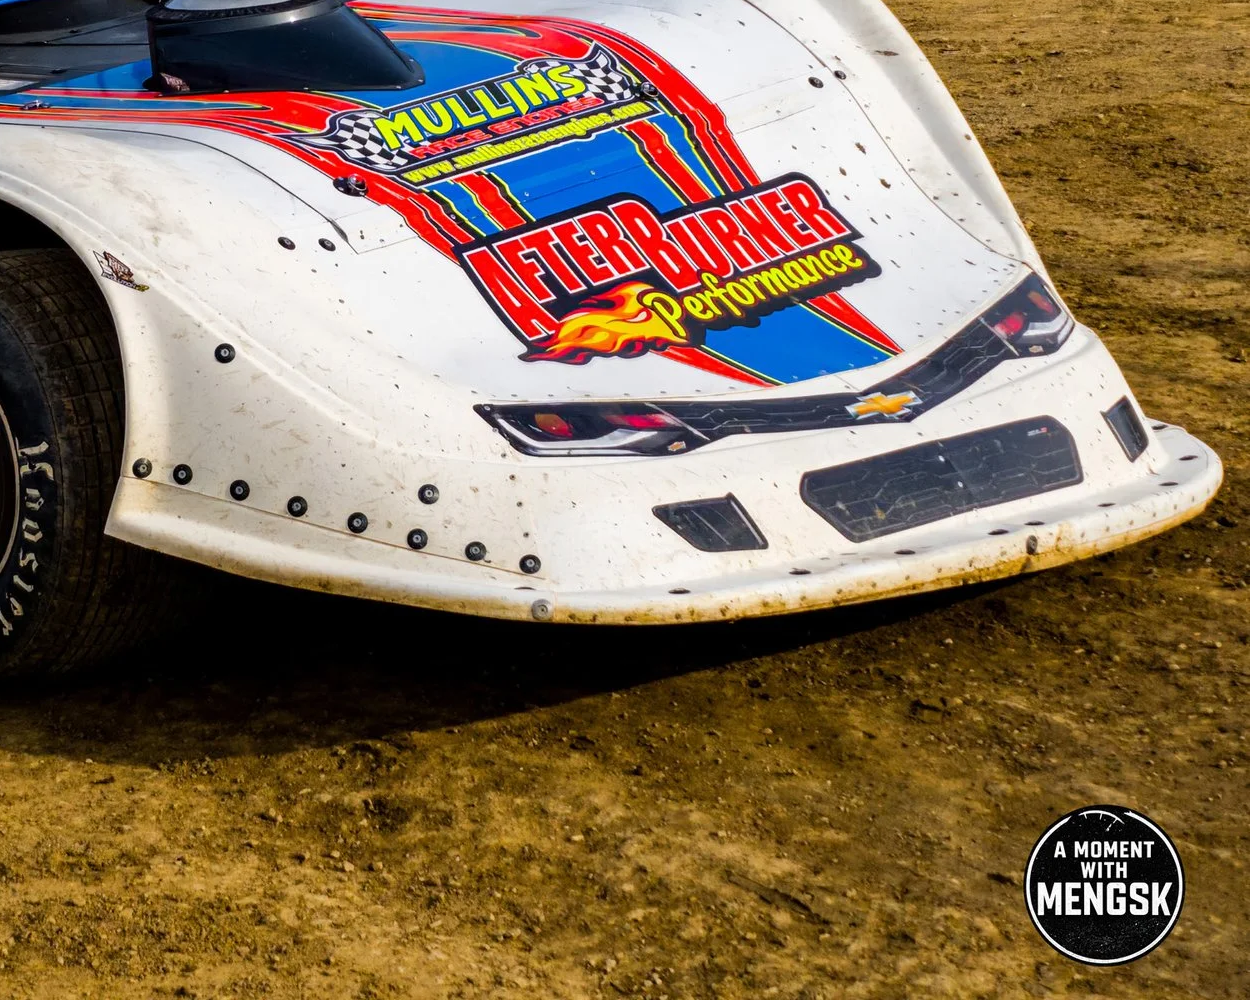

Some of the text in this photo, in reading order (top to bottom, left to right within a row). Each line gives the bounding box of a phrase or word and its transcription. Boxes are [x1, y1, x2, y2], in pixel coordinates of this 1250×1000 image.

[373, 64, 587, 150] MULLINS
[408, 95, 606, 159] RACE ENGINES
[644, 242, 865, 340] Performance
